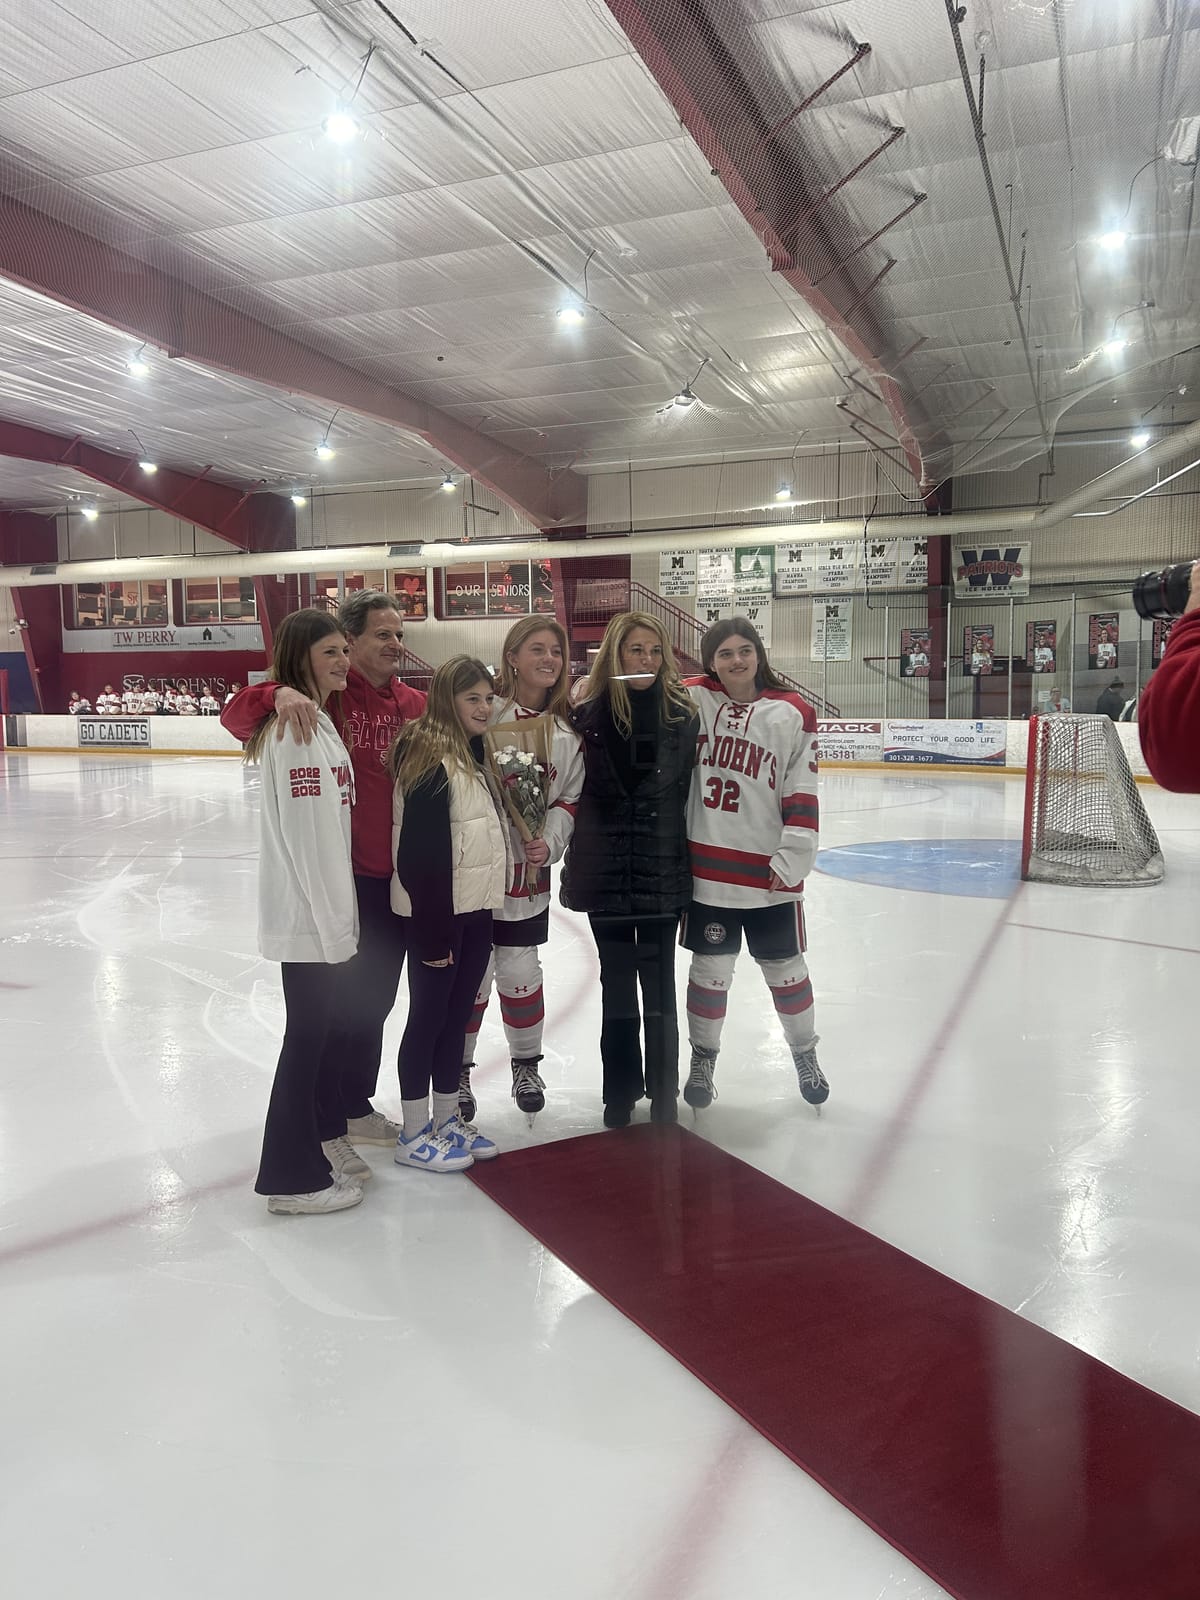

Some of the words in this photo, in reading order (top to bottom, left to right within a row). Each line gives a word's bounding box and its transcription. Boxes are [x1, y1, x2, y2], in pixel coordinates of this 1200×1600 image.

[788, 549, 803, 562] M
[829, 547, 844, 560] M
[871, 544, 886, 558] M
[671, 556, 684, 569] M
[709, 555, 722, 566] M
[957, 560, 1024, 582] PATRIOTS
[455, 584, 481, 597] OUR
[490, 583, 530, 597] SENIORS
[706, 610, 720, 622] M
[746, 608, 759, 620] W
[826, 605, 839, 618] M
[114, 631, 134, 644] TW
[137, 630, 177, 643] PERRY
[80, 724, 95, 740] GO
[99, 724, 148, 741] CADETS
[892, 735, 924, 743] PROTECT
[289, 767, 321, 780] 2022
[291, 785, 322, 798] 2023
[703, 776, 741, 813] 32
